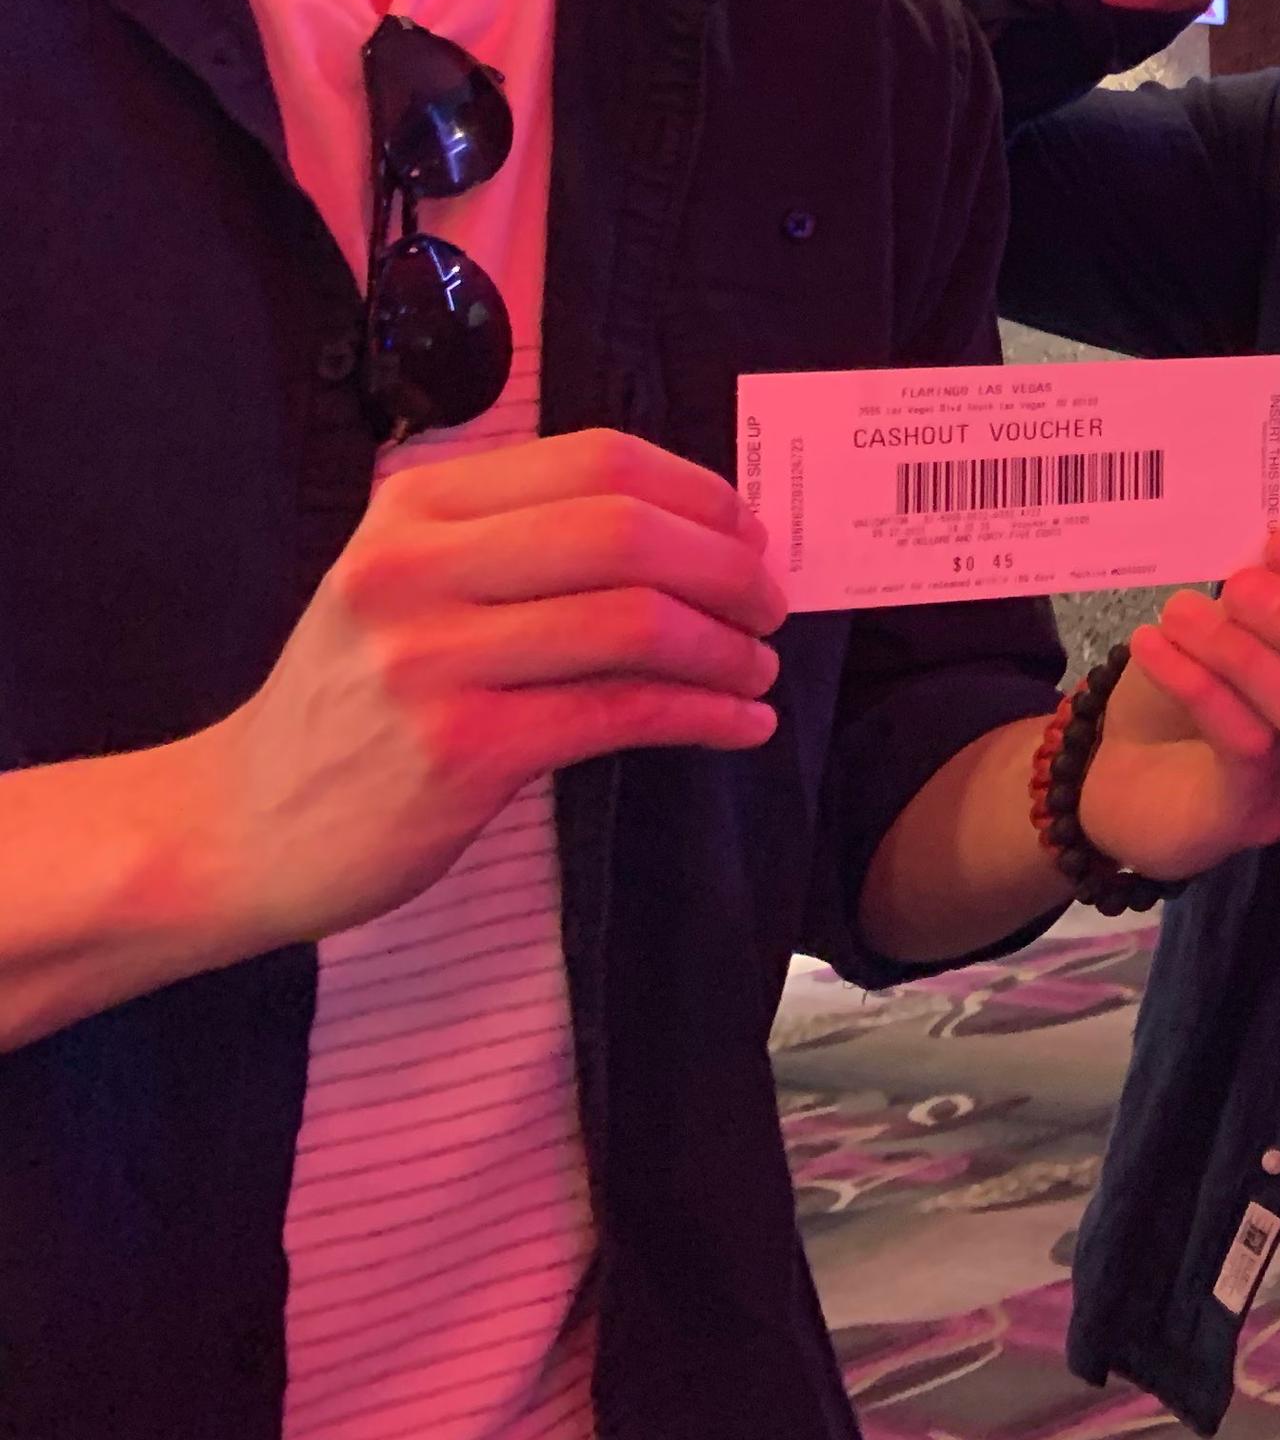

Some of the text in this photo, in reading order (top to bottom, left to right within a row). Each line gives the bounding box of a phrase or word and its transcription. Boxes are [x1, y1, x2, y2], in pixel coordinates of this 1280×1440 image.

[978, 384, 1002, 396] LAS
[1011, 382, 1052, 395] VEGAS
[747, 415, 761, 438] UP
[853, 418, 1104, 448] CASHOUT VOUCHER
[747, 441, 761, 477] SIDE
[1267, 448, 1280, 481] THIS
[1266, 483, 1280, 517] SIDE
